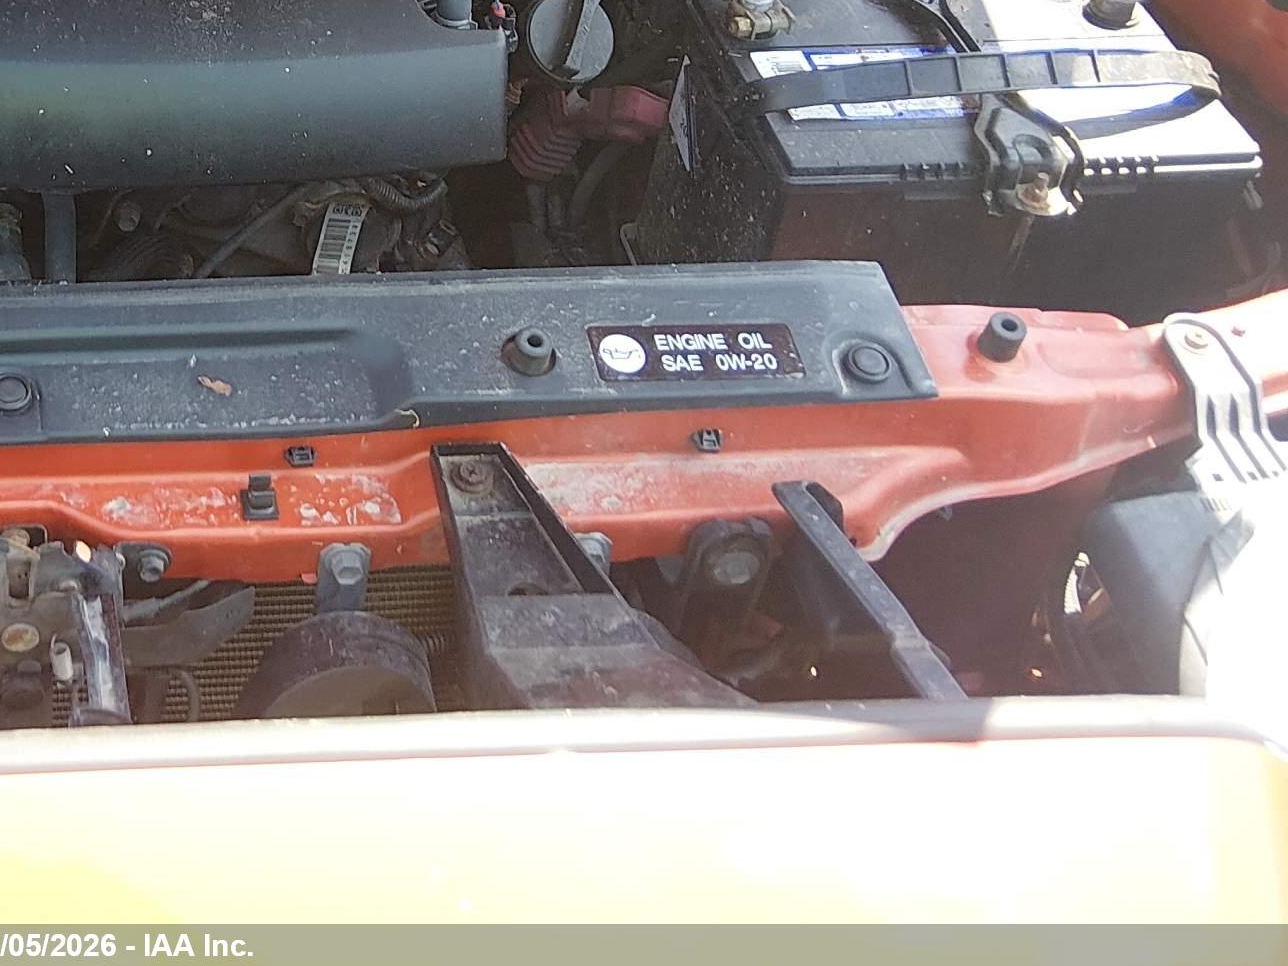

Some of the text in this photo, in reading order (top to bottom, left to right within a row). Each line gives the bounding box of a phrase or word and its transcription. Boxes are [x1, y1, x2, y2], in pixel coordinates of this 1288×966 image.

[654, 333, 773, 351] ENGINE OIL
[661, 353, 778, 372] SAE 0W-20
